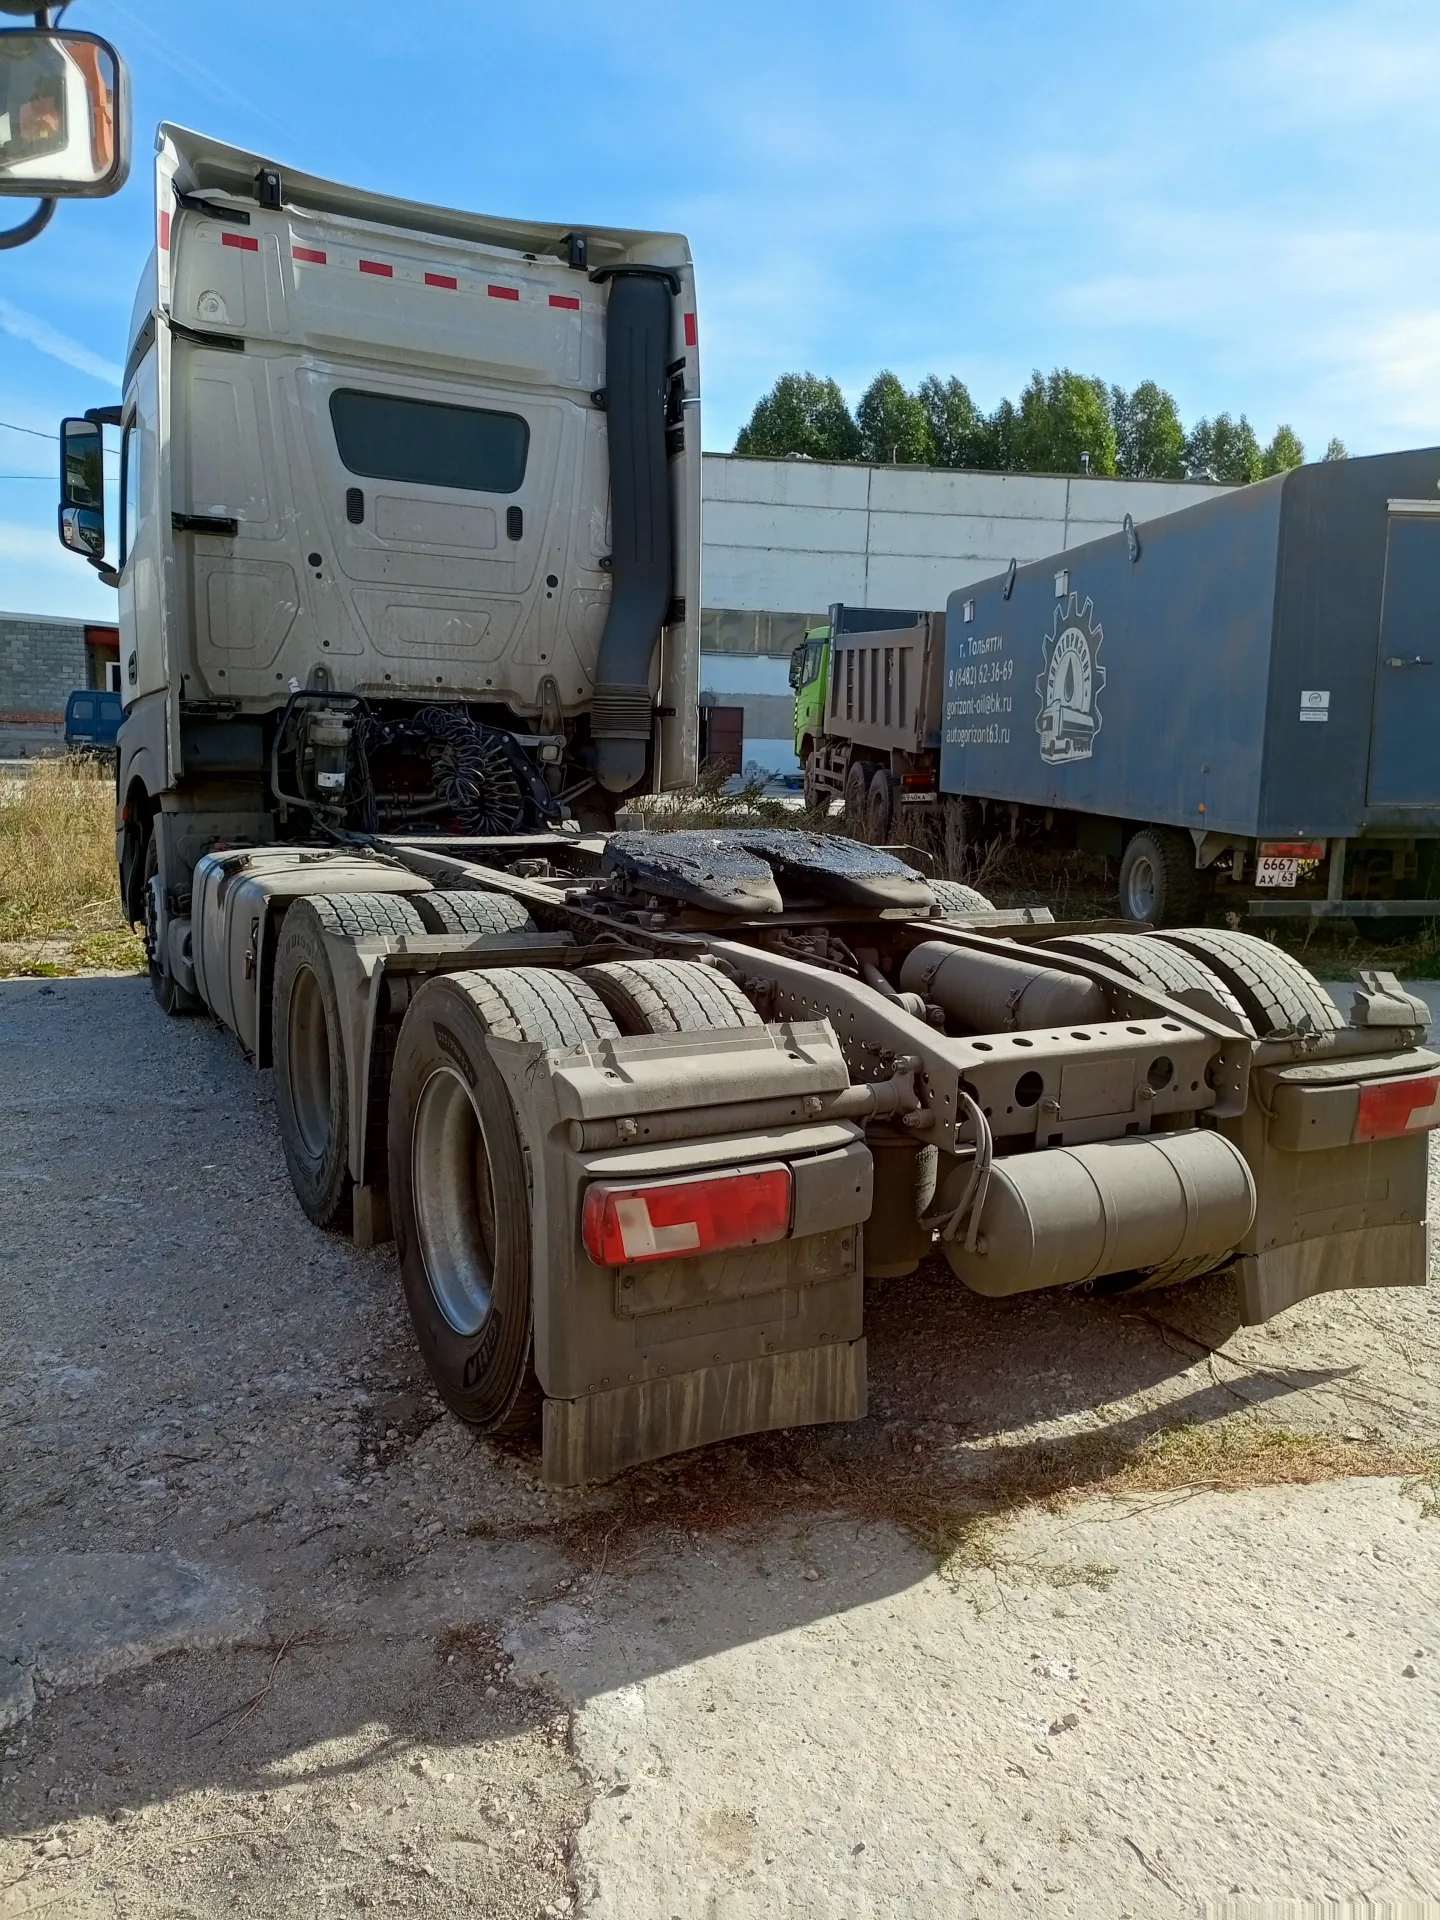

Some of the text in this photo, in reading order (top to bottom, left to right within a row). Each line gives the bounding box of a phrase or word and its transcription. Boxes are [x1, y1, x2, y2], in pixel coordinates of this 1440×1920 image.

[959, 635, 1003, 658] г. Тольятти
[1048, 633, 1090, 688] АВТОГОРИЗОНТ
[948, 659, 1013, 690] 8 (8482) 62-36-69
[946, 692, 1012, 720] gorizont-oil@bk.ru
[946, 723, 1010, 747] autogorizont63.ru
[1263, 858, 1294, 871] 6667
[1281, 872, 1294, 882] 63
